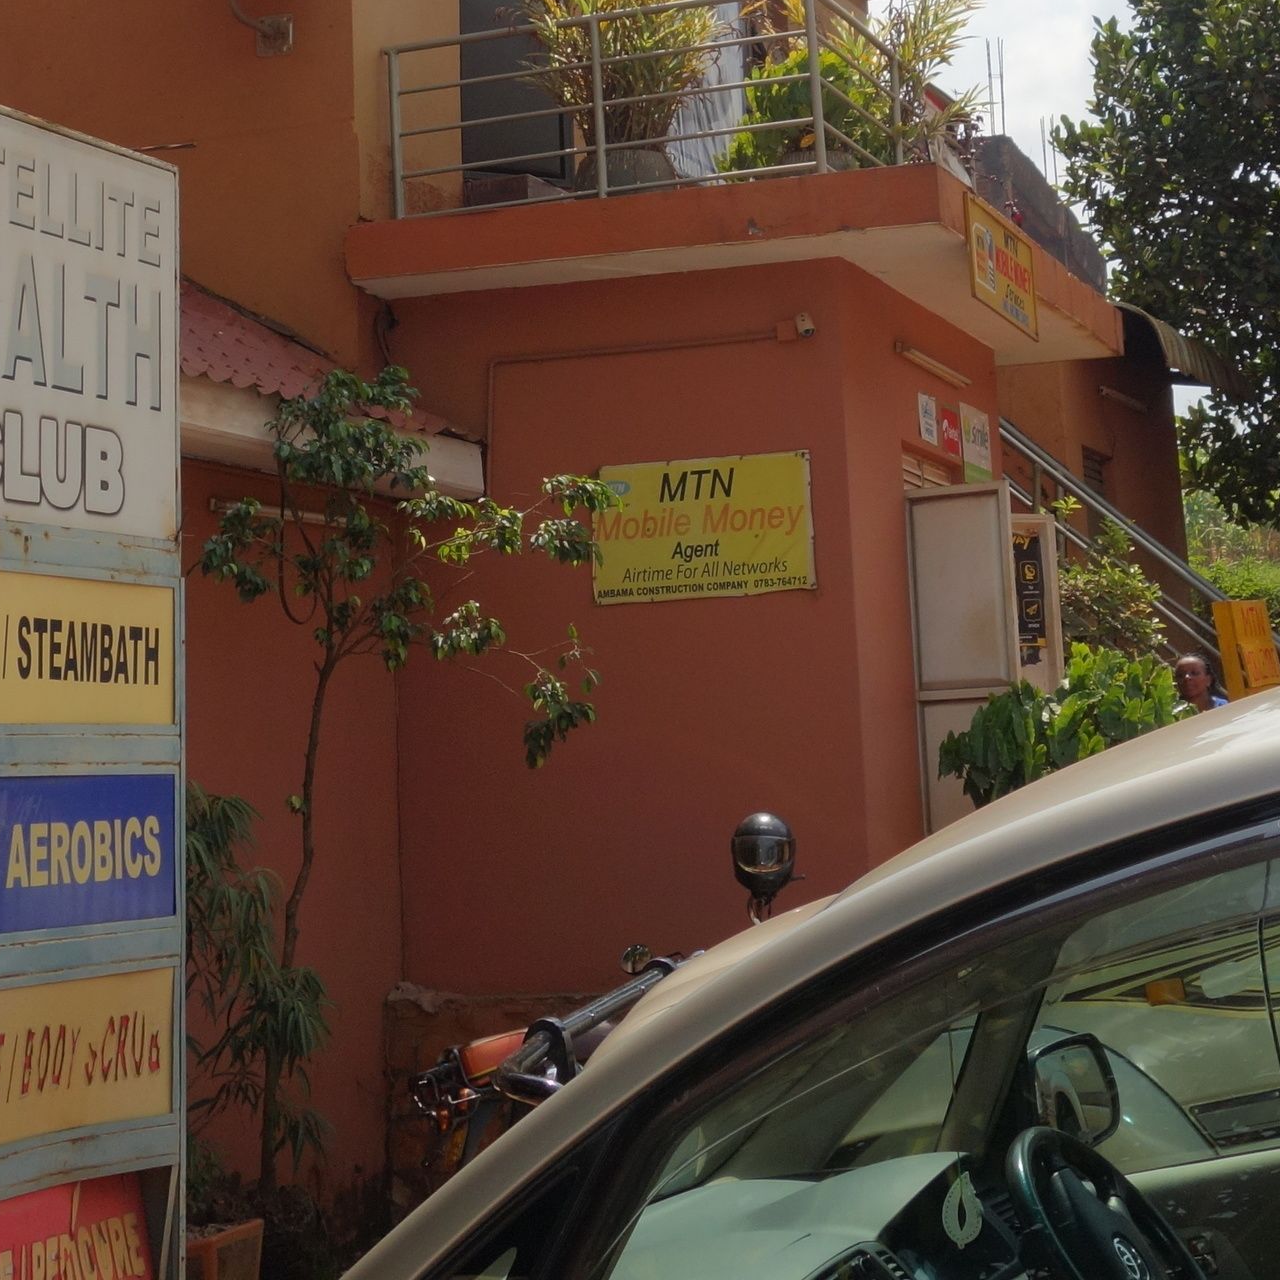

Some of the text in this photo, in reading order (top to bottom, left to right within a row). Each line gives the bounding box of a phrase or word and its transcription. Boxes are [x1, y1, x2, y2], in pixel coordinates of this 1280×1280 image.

[659, 467, 735, 504] MTN
[594, 502, 805, 543] Mobile Money
[671, 539, 721, 563] Agent
[622, 556, 788, 584] Airtime For All Networks
[636, 583, 705, 597] CONSTRUCTION
[706, 578, 749, 592] COMPANY
[18, 615, 160, 686] STEAMBATH
[5, 815, 162, 889] AEROBICS
